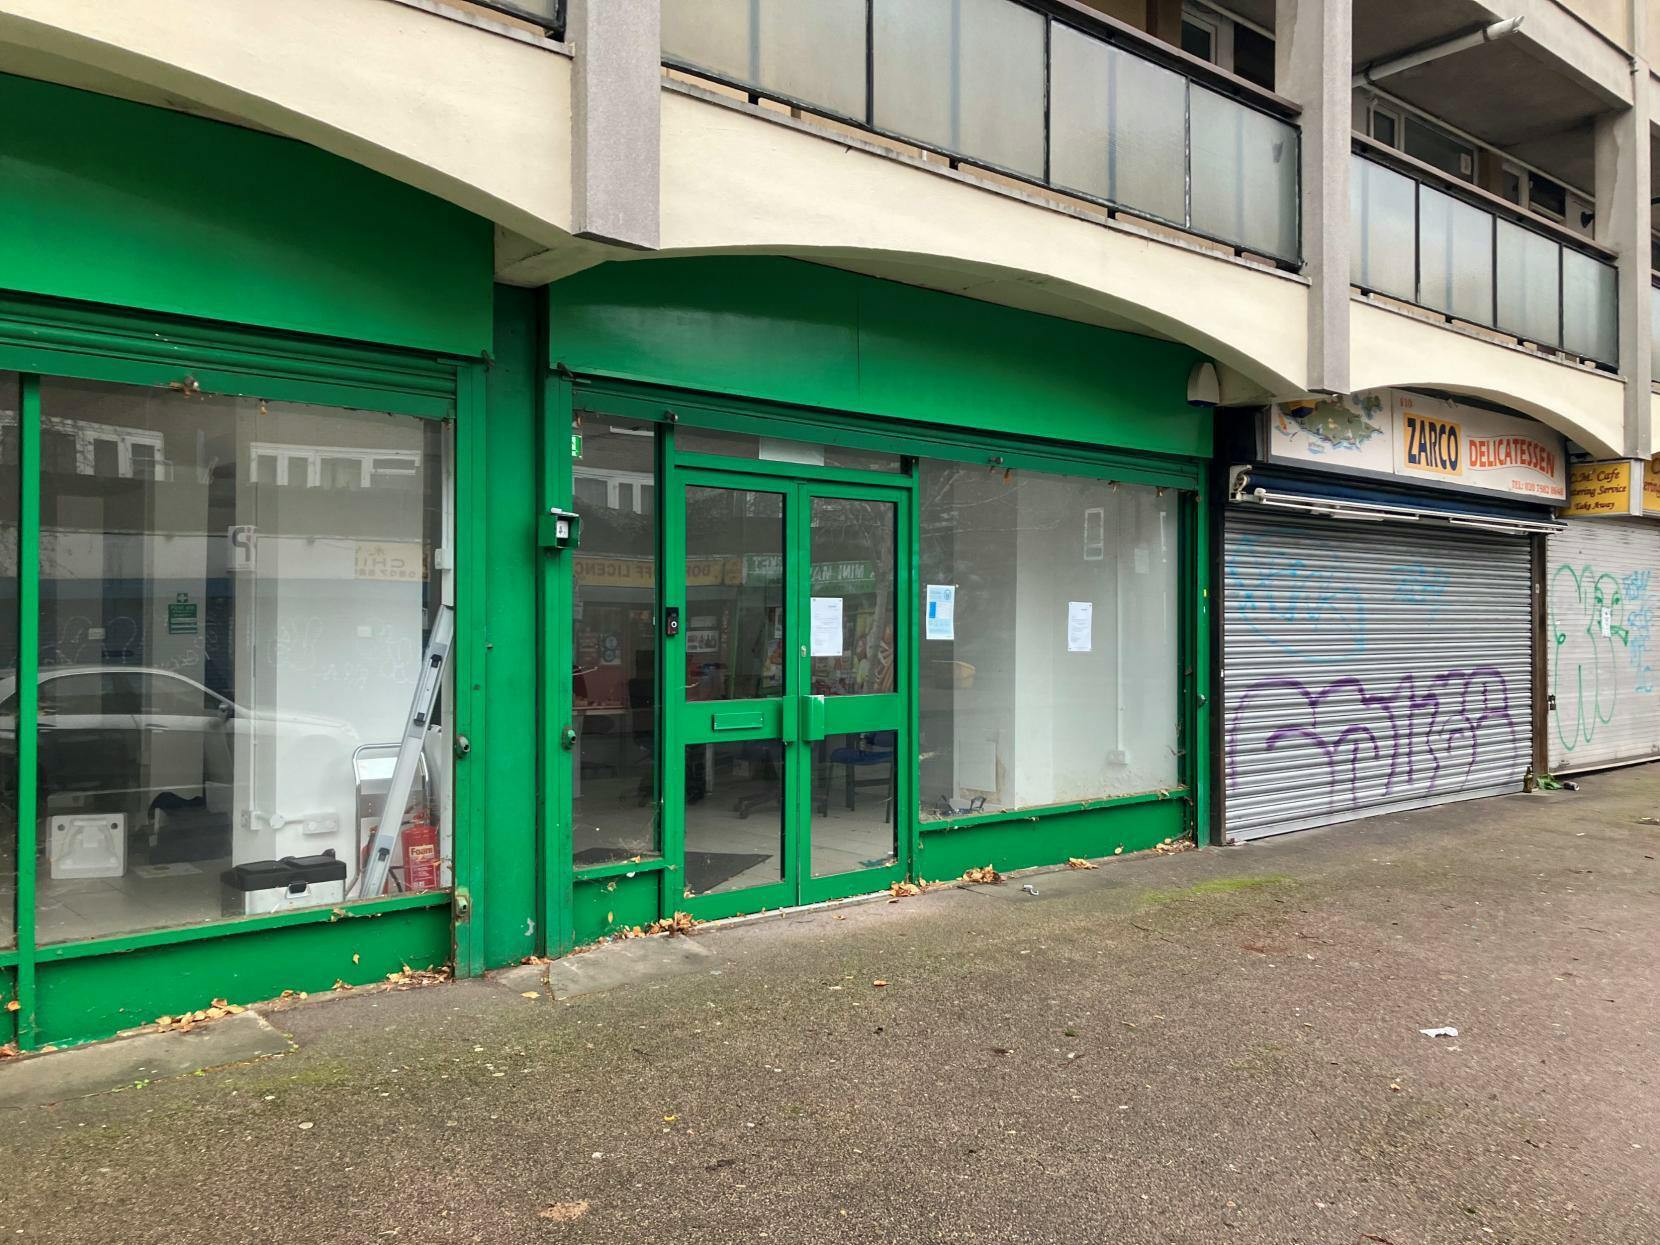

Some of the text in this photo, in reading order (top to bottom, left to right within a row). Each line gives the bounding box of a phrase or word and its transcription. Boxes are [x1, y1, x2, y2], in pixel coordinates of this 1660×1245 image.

[1407, 417, 1459, 471] ZARCO
[1469, 438, 1555, 478] DELICATESSEN
[411, 848, 433, 856] Foam
